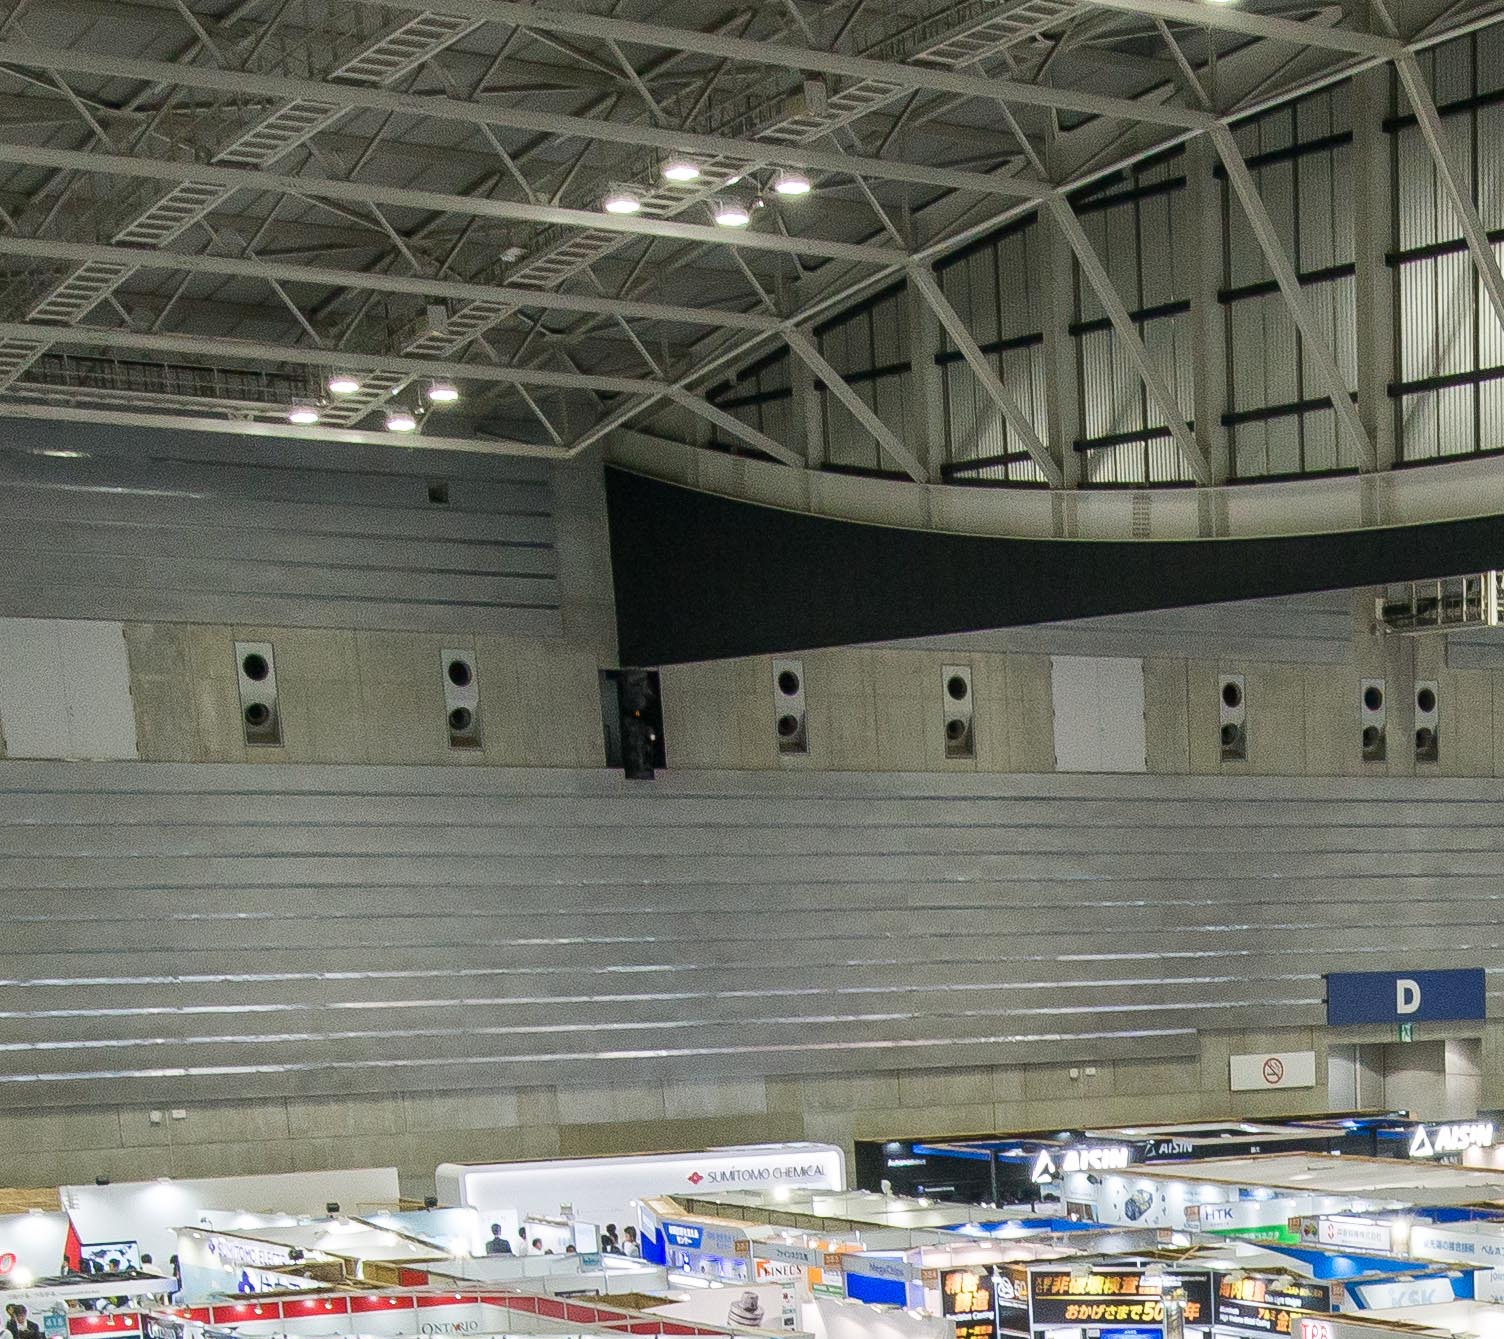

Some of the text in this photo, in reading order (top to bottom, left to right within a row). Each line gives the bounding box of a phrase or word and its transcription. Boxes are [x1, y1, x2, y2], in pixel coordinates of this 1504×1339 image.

[1396, 979, 1420, 1015] D
[1159, 1142, 1194, 1155] AISIN
[1434, 1124, 1494, 1151] AISIN
[1063, 1148, 1129, 1171] AISIN
[1205, 1207, 1233, 1221] HTK
